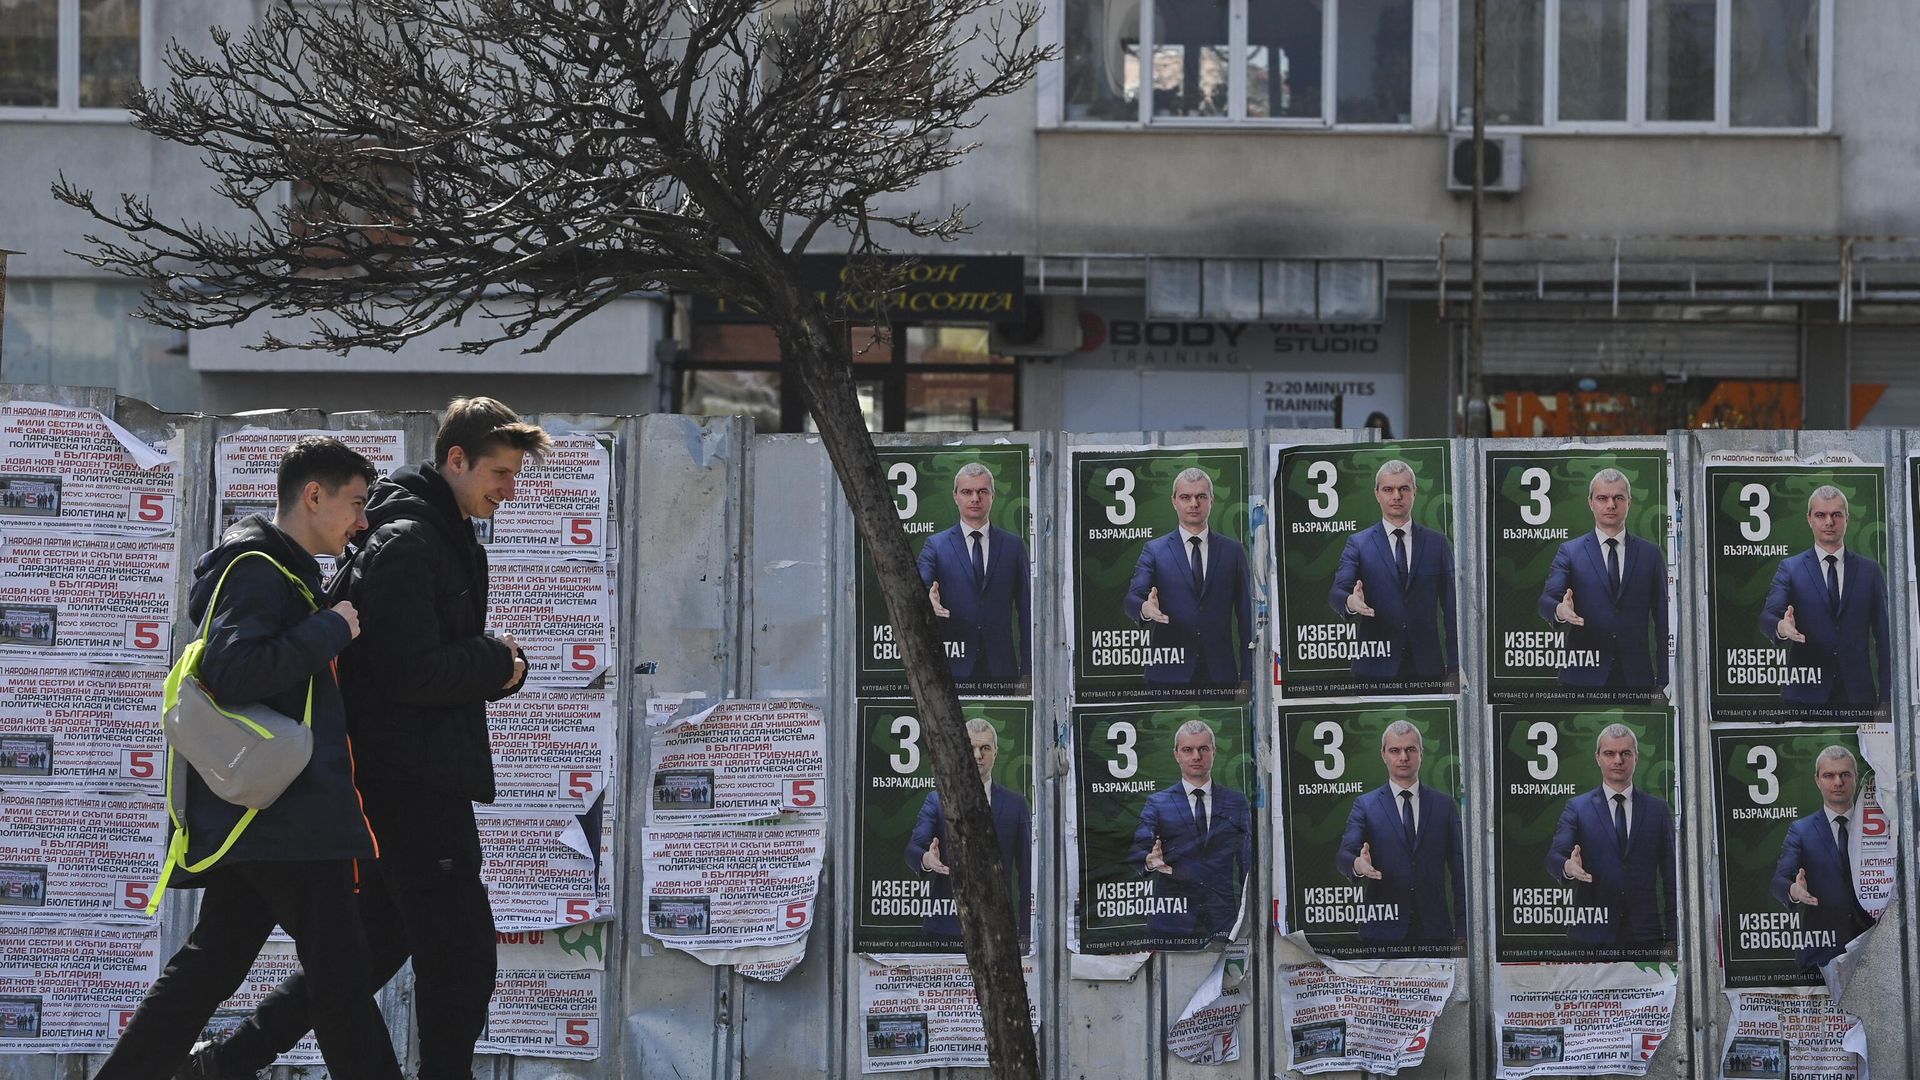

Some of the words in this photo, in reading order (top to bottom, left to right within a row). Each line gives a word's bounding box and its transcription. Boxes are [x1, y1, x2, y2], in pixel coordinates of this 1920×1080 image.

[1109, 320, 1248, 347] BODY
[1267, 323, 1383, 334] VICTORY
[1274, 337, 1378, 353] STUDIO
[1111, 351, 1238, 364] TRAINING
[1305, 382, 1375, 396] MINUTES
[54, 450, 60, 458] В
[63, 451, 123, 461] БЪЛГАРИЯ!
[888, 462, 918, 520] 3
[1106, 468, 1135, 525] 3
[1308, 461, 1338, 518] 3
[1521, 468, 1551, 525] 3
[62, 509, 114, 519] БЮЛЕТИНА
[116, 511, 126, 519] №
[139, 495, 164, 521] 5
[1740, 484, 1770, 541] 3
[571, 519, 593, 545] 5
[1090, 528, 1152, 539] ВЪЗРАЖДАНЕ
[1293, 521, 1356, 533] ВЪЗРАЖДАНЕ
[1504, 529, 1568, 540] ВЪЗРАЖДАНЕ
[8, 538, 42, 546] НАРОДНА
[43, 539, 71, 547] ПАРТИЯ
[72, 540, 108, 548] ИСТИНАТА
[116, 541, 137, 549] САМО
[138, 542, 175, 550] ИСТИНАТА
[495, 536, 547, 544] БЮЛЕТИНА
[549, 536, 559, 545] №
[12, 549, 40, 557] МИЛИ
[42, 550, 78, 558] СЕСТРИ
[124, 553, 158, 561] БРАТЯ!
[1724, 545, 1788, 556] ВЪЗРАЖДАНЕ
[18, 565, 86, 573] ПАРАЗИТНАТА
[88, 567, 150, 575] САТАНИНСКА
[21, 557, 41, 565] СМЕ
[44, 558, 94, 566] ПРИЗВАНИ
[112, 560, 170, 569] УНИЩОЖИМ
[5, 571, 73, 580] ПОЛИТИЧЕСКА
[76, 573, 106, 581] КЛАСА
[118, 574, 163, 583] СИСТЕМА
[50, 580, 56, 588] В
[58, 580, 118, 589] БЪЛГАРИЯ!
[0, 587, 26, 595] ИДВА
[29, 588, 49, 596] НОВ
[51, 589, 95, 597] НАРОДЕН
[99, 590, 155, 599] ТРИБУНАЛ
[158, 592, 165, 600] И
[54, 595, 66, 603] ЗА
[68, 596, 104, 604] ЦЯЛАТА
[106, 597, 169, 606] САТАНИНСКА
[68, 604, 138, 613] ПОЛИТИЧЕСКА
[140, 606, 169, 614] СГАН!
[135, 622, 160, 649] 5
[1092, 630, 1150, 647] ИЗБЕРИ
[1297, 623, 1357, 641] ИЗБЕРИ
[1504, 632, 1565, 648] ИЗБЕРИ
[57, 638, 110, 647] БЮЛЕТИНА
[112, 639, 122, 647] №
[1298, 641, 1391, 660] СВОБОДАТА!
[573, 644, 596, 671] 5
[1092, 648, 1185, 666] СВОБОДАТА!
[1504, 650, 1600, 667] СВОБОДАТА!
[1727, 649, 1787, 665] ИЗБЕРИ
[1727, 667, 1822, 685] СВОБОДАТА!
[1378, 682, 1403, 690] ГЛАСОВЕ
[1409, 681, 1455, 689] ПРЕСТЪПЛЕНИЕ!
[1493, 691, 1529, 699] КУПУВАНЕТО
[705, 744, 711, 752] В
[714, 743, 772, 752] БЪЛГАРИЯ!
[890, 716, 920, 773] 3
[1107, 722, 1137, 778] 3
[1314, 722, 1345, 779] 3
[1528, 722, 1558, 780] 3
[54, 768, 105, 776] БЮЛЕТИНА
[108, 768, 118, 776] №
[131, 752, 153, 778] 5
[873, 776, 936, 789] ВЪЗРАЖДАНЕ
[1747, 746, 1779, 804] 3
[571, 772, 592, 797] 5
[1092, 781, 1155, 792] ВЪЗРАЖДАНЕ
[1299, 782, 1362, 794] ВЪЗРАЖДАНЕ
[1511, 784, 1575, 795] ВЪЗРАЖДАНЕ
[793, 780, 816, 807] 5
[715, 799, 768, 808] БЮЛЕТИНА
[770, 799, 780, 808] №
[1733, 807, 1797, 819] ВЪЗРАЖДАНЕ
[1863, 809, 1885, 835] 5
[49, 840, 108, 849] БЪЛГАРИЯ!
[693, 841, 728, 849] СЕСТРИ
[773, 840, 805, 848] БРАТЯ!
[702, 870, 707, 879] В
[710, 870, 769, 878] БЪЛГАРИЯ!
[127, 883, 148, 908] 5
[872, 880, 930, 898] ИЗБЕРИ
[1097, 880, 1154, 899] ИЗБЕРИ
[1304, 887, 1363, 904] ИЗБЕРИ
[1513, 888, 1574, 905] ИЗБЕРИ
[46, 899, 99, 907] БЮЛЕТИНА
[102, 899, 112, 907] №
[1097, 898, 1188, 917] СВОБОДАТА!
[567, 900, 590, 923] 5
[787, 903, 805, 928] 5
[1305, 904, 1399, 923] СВОБОДАТА!
[1513, 907, 1608, 925] СВОБОДАТА!
[711, 924, 763, 934] БЮЛЕТИНА
[1739, 912, 1800, 930] ИЗБЕРИ
[1740, 931, 1836, 949] СВОБОДАТА!
[1555, 1002, 1561, 1010] В
[1563, 1001, 1622, 1010] БЪЛГАРИЯ!
[41, 1029, 92, 1037] БЮЛЕТИНА
[95, 1029, 106, 1037] №
[490, 1036, 541, 1044] БЮЛЕТИНА
[544, 1036, 554, 1044] №
[567, 1021, 588, 1044] 5
[1565, 1052, 1617, 1062] БЮЛЕТИНА
[1619, 1051, 1629, 1060] №
